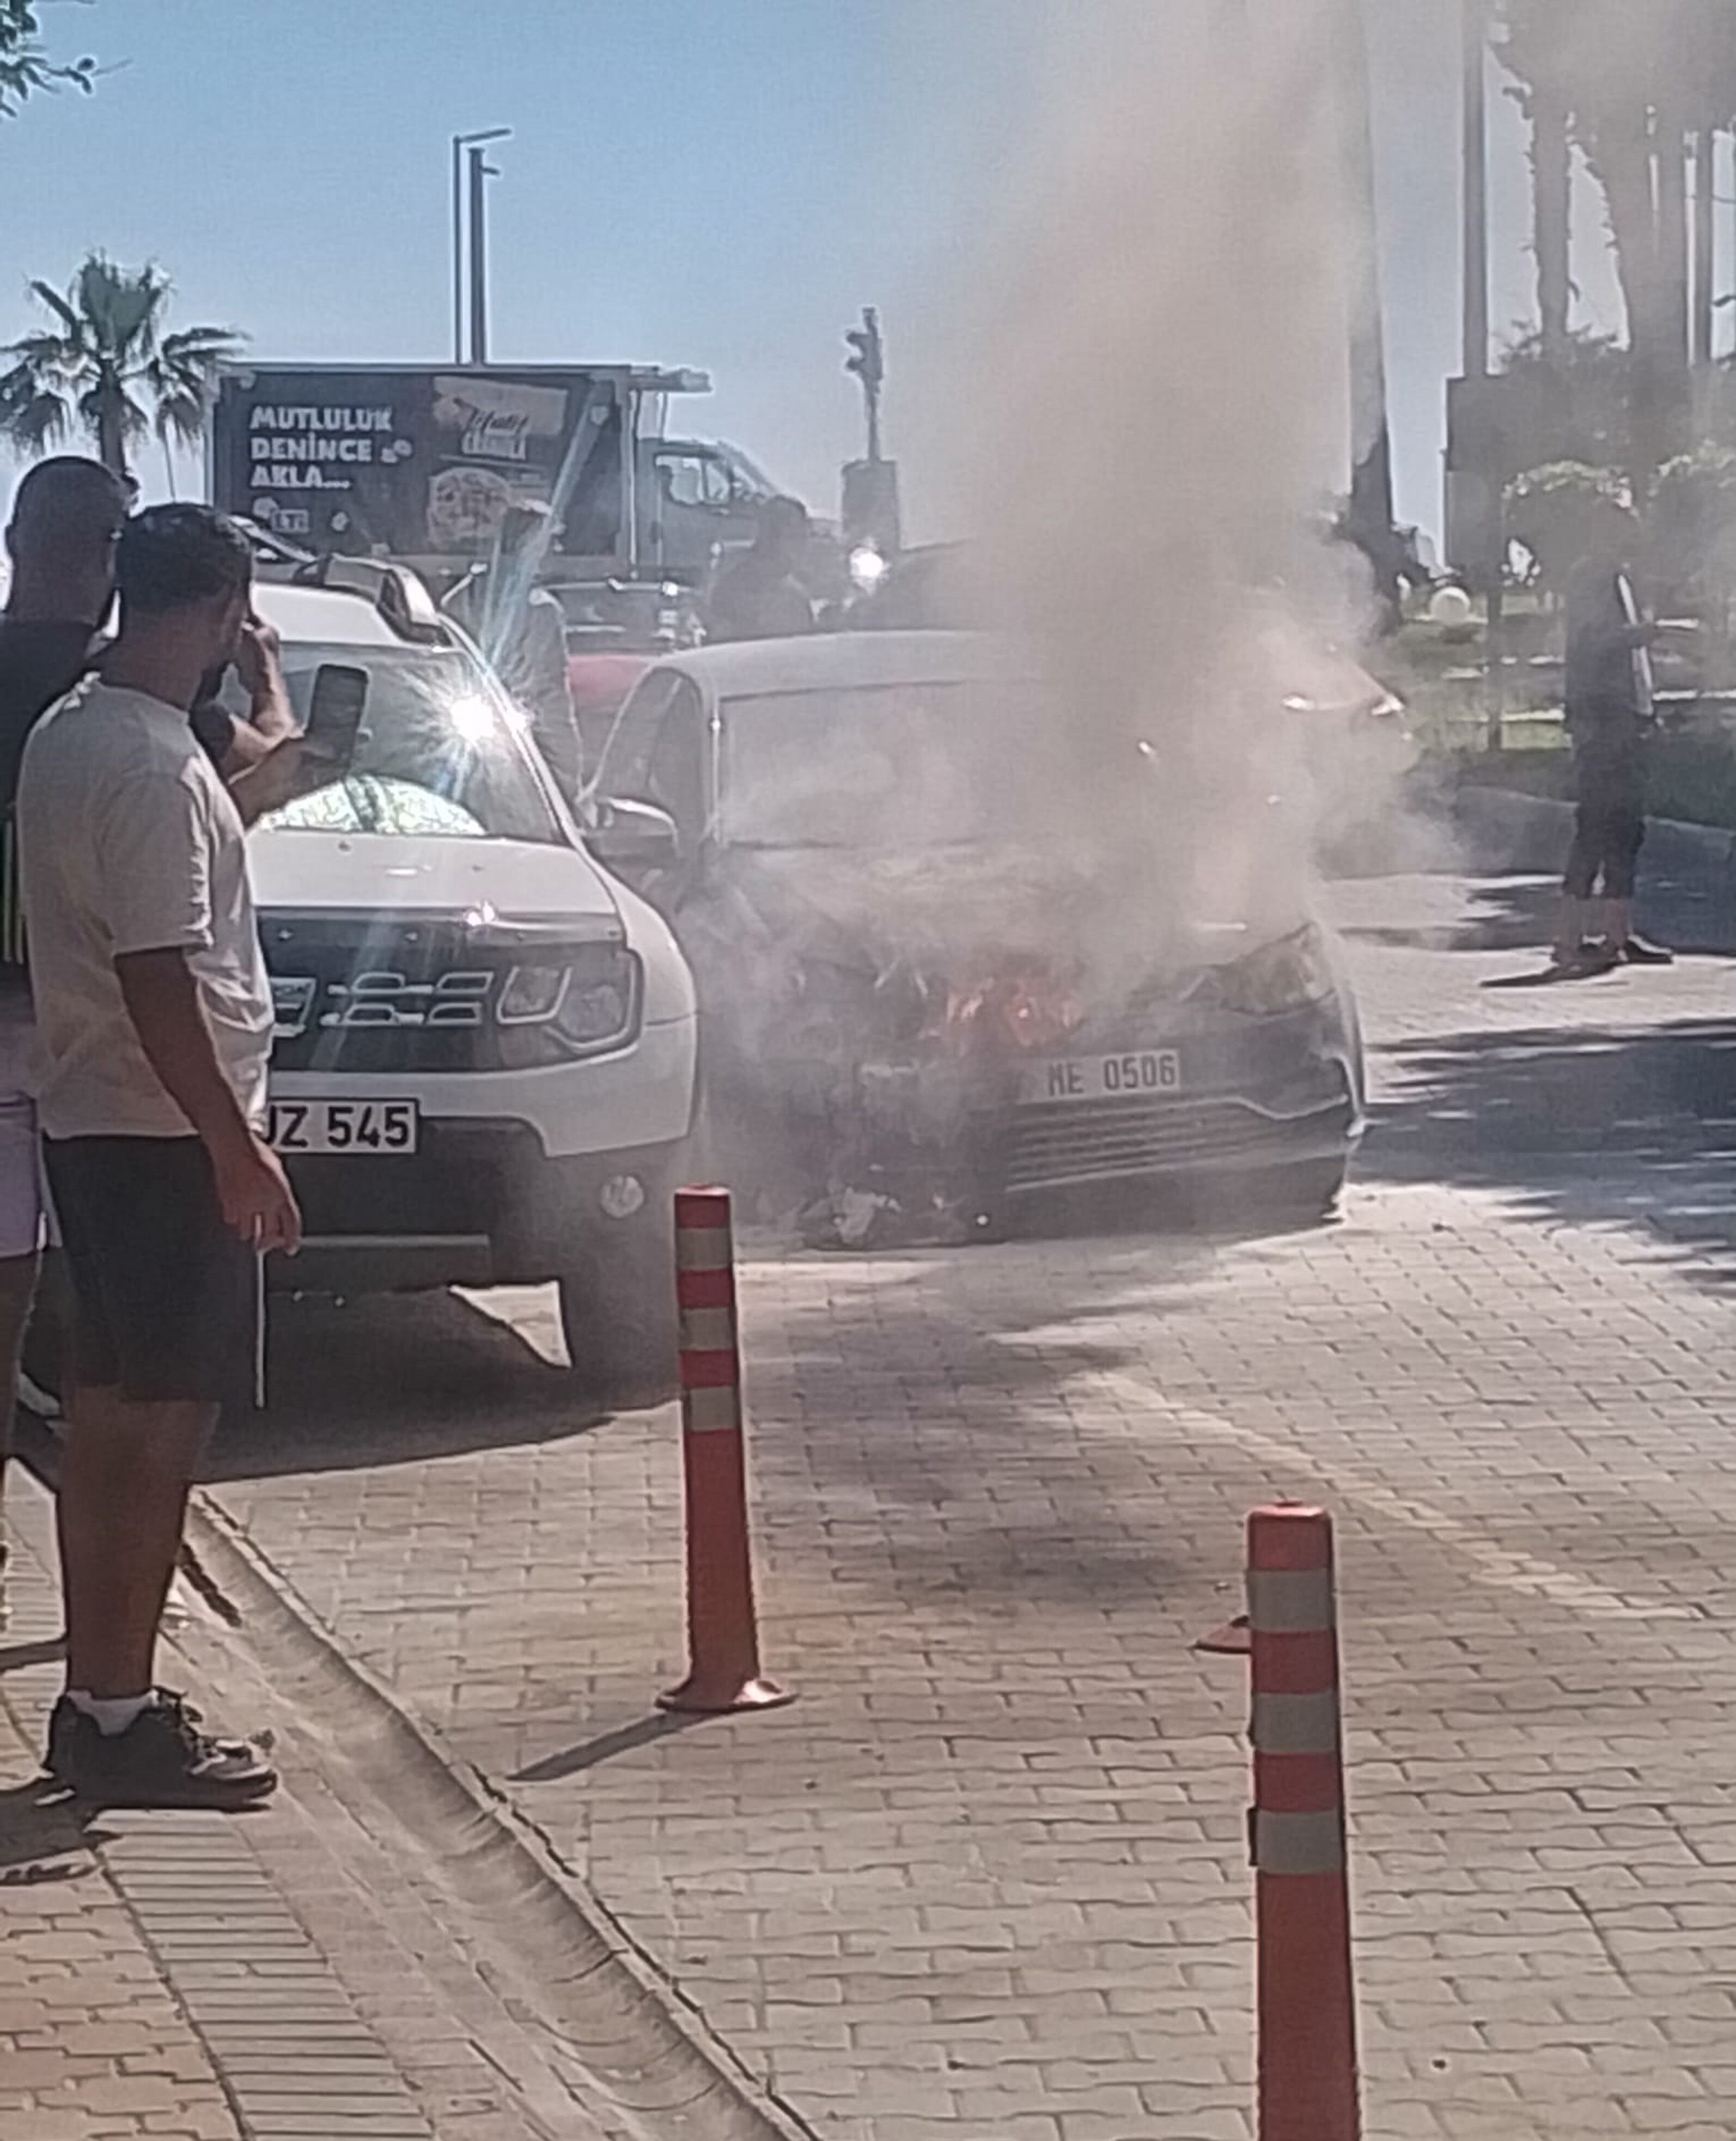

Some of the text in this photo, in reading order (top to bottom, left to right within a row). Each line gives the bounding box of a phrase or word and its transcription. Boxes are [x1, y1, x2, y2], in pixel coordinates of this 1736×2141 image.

[249, 406, 393, 432] MUTLULUK
[251, 431, 373, 462] DENİNCE
[1104, 1053, 1175, 1090] 0506
[327, 1105, 409, 1148] 545
